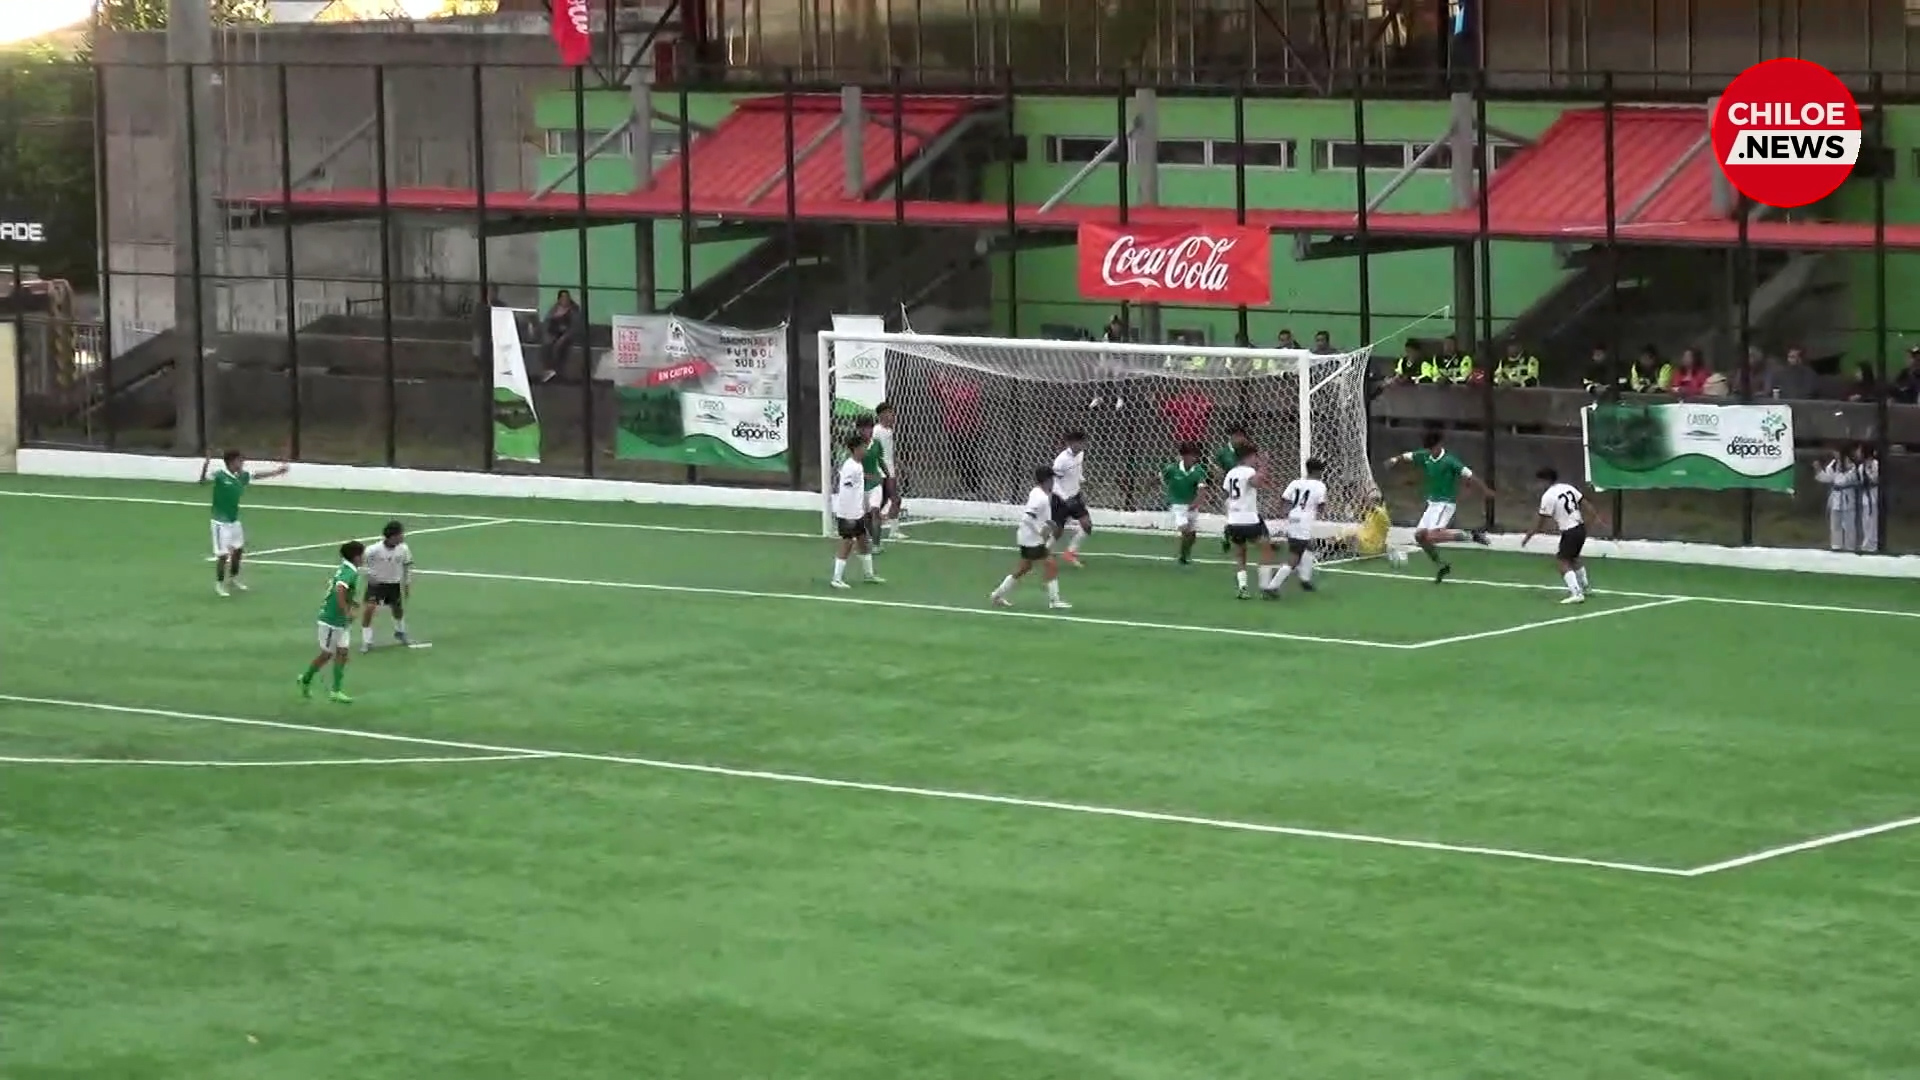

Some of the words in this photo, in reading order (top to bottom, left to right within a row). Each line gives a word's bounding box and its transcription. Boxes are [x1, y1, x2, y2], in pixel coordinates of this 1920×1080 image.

[1102, 235, 1238, 291] Coca-Cola
[735, 358, 754, 368] SUB
[1687, 413, 1719, 426] CASTRO
[732, 425, 781, 441] deportes
[1726, 441, 1782, 458] deportes
[1229, 478, 1240, 500] 15
